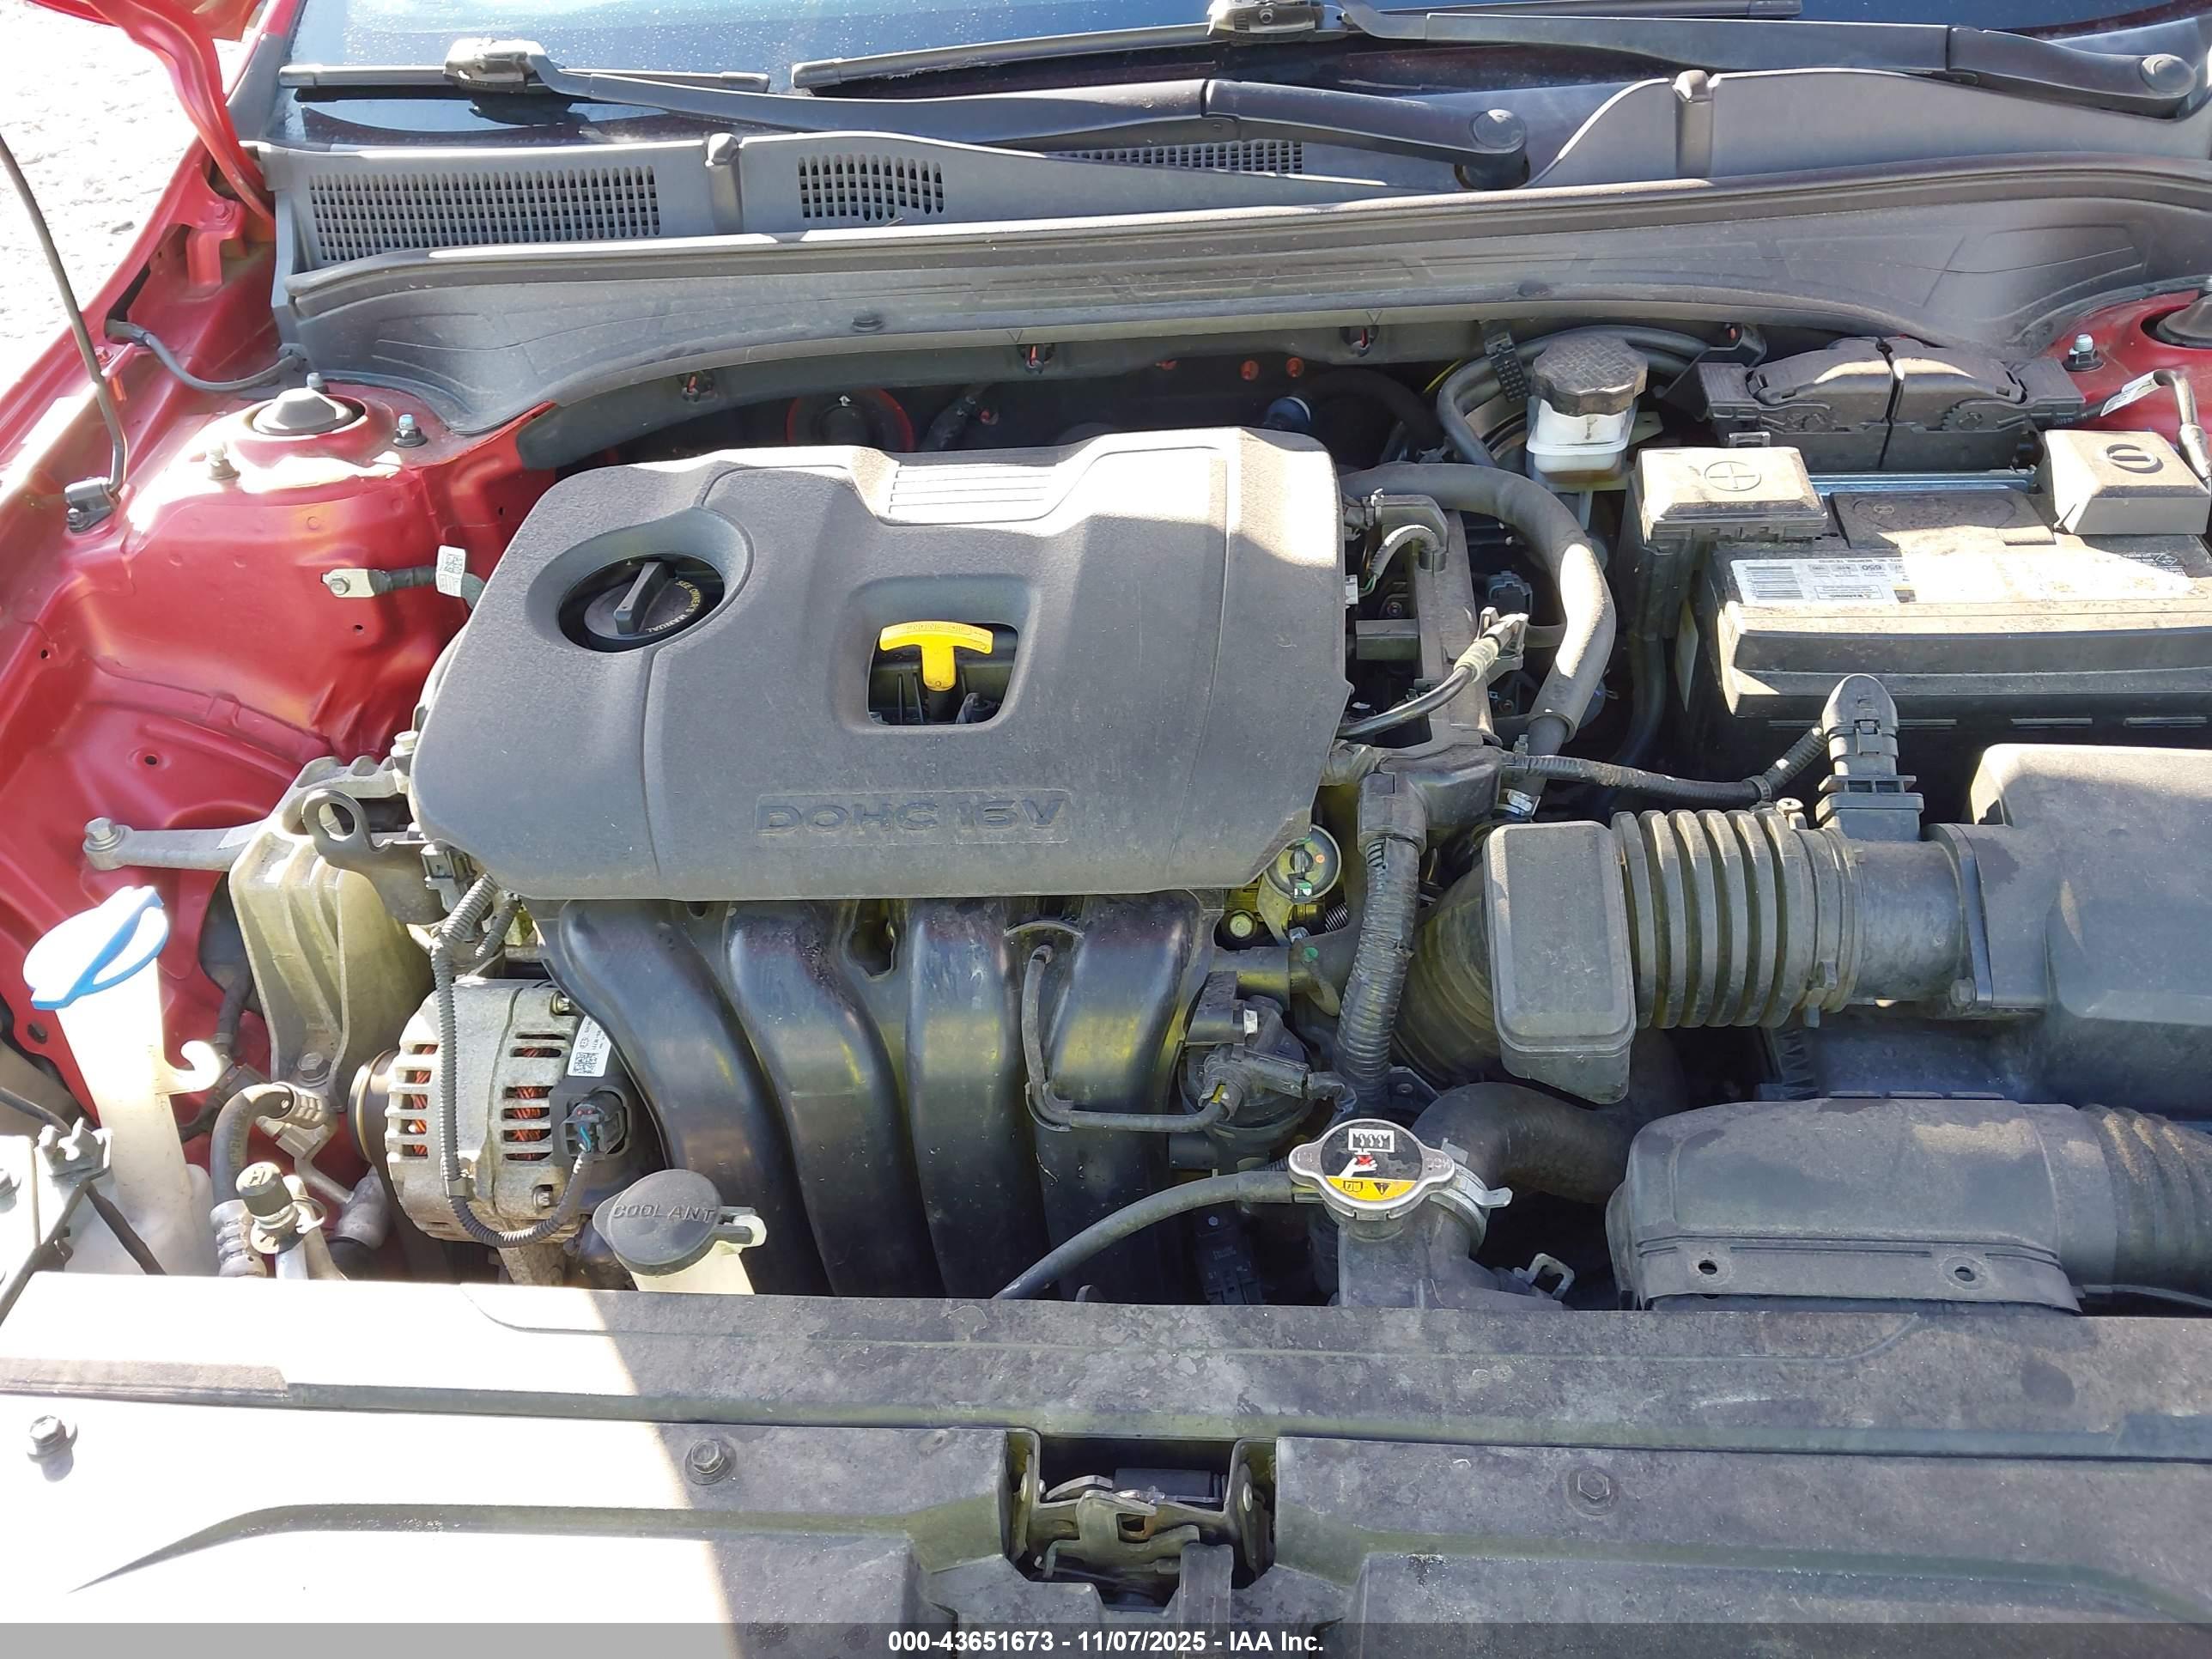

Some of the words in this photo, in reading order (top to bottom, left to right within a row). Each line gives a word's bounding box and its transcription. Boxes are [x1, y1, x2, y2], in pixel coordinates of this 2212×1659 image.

[674, 580, 693, 590] SEE
[646, 614, 687, 633] MANUAL
[757, 802, 939, 833] DOHC
[957, 799, 1065, 829] 16V
[613, 1204, 715, 1223] COOLANT
